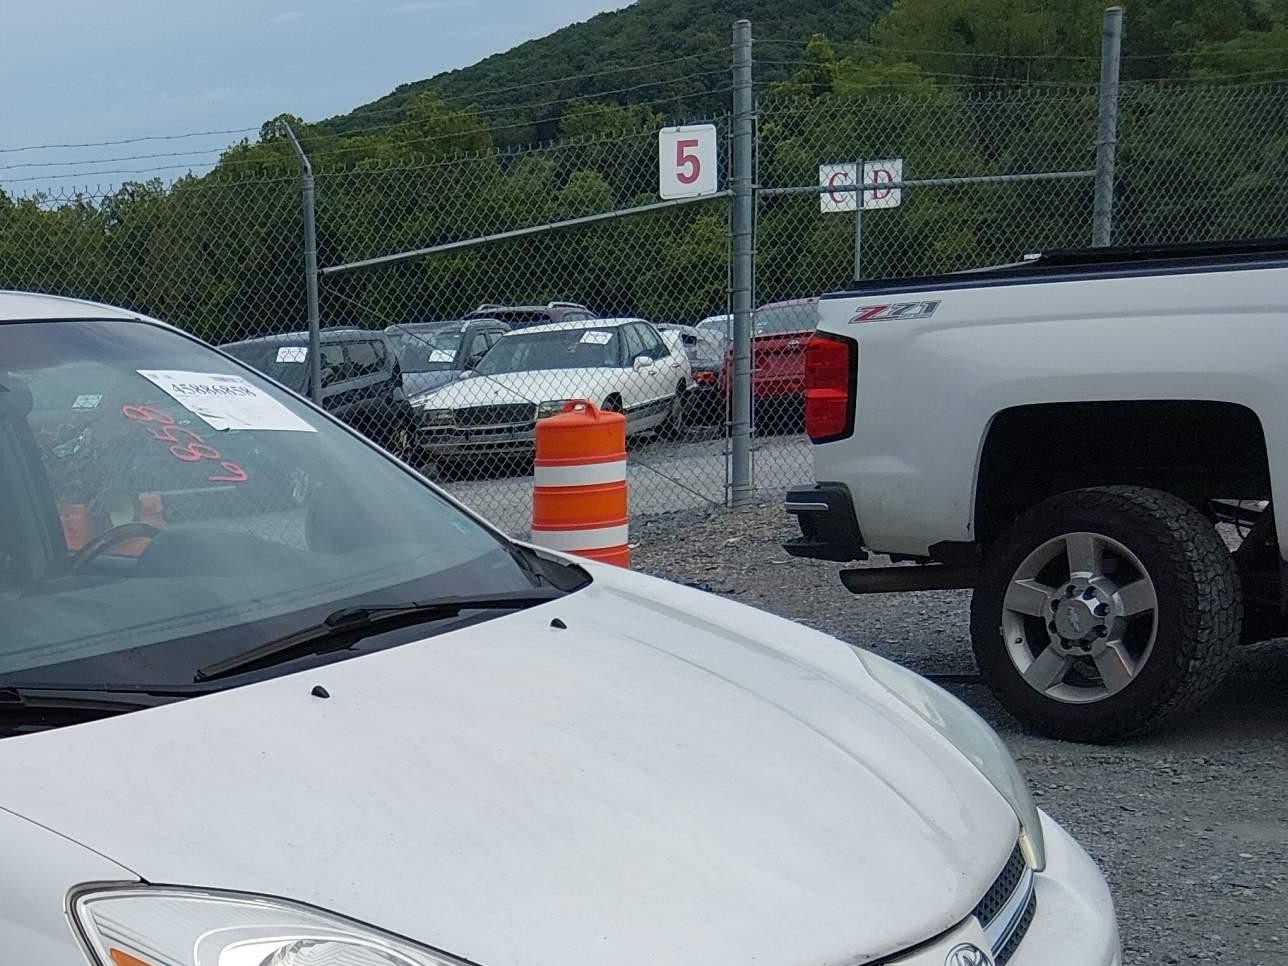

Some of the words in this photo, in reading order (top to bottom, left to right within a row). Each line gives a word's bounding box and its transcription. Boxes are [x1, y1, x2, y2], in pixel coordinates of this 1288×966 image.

[675, 139, 701, 184] 5
[828, 172, 848, 203] C
[872, 170, 894, 199] D
[848, 300, 942, 324] Z71
[171, 383, 256, 397] 45886858
